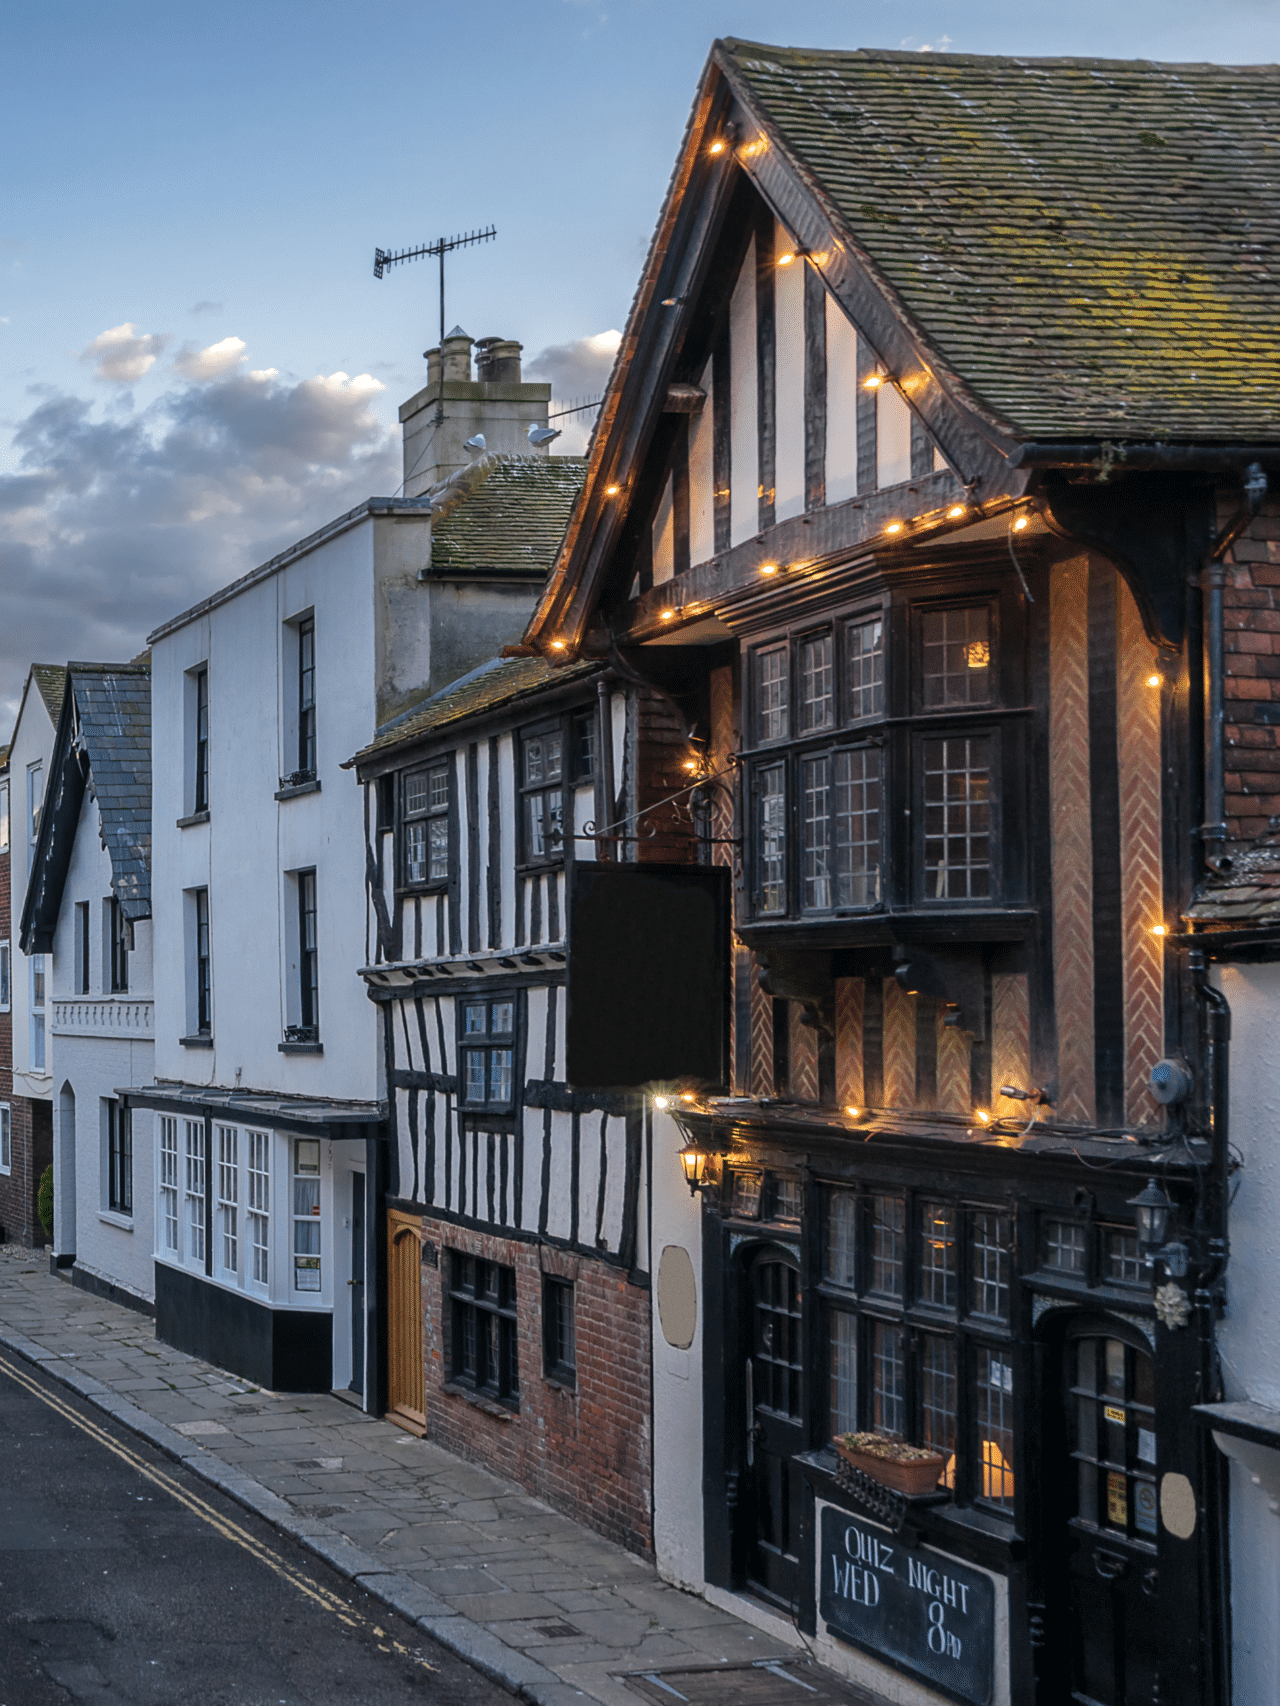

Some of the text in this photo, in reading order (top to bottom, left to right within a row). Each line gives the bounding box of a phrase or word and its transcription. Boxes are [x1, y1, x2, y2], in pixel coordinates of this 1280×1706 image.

[832, 1554, 879, 1606] WED
[845, 1526, 970, 1615] QUIZ NIGHT
